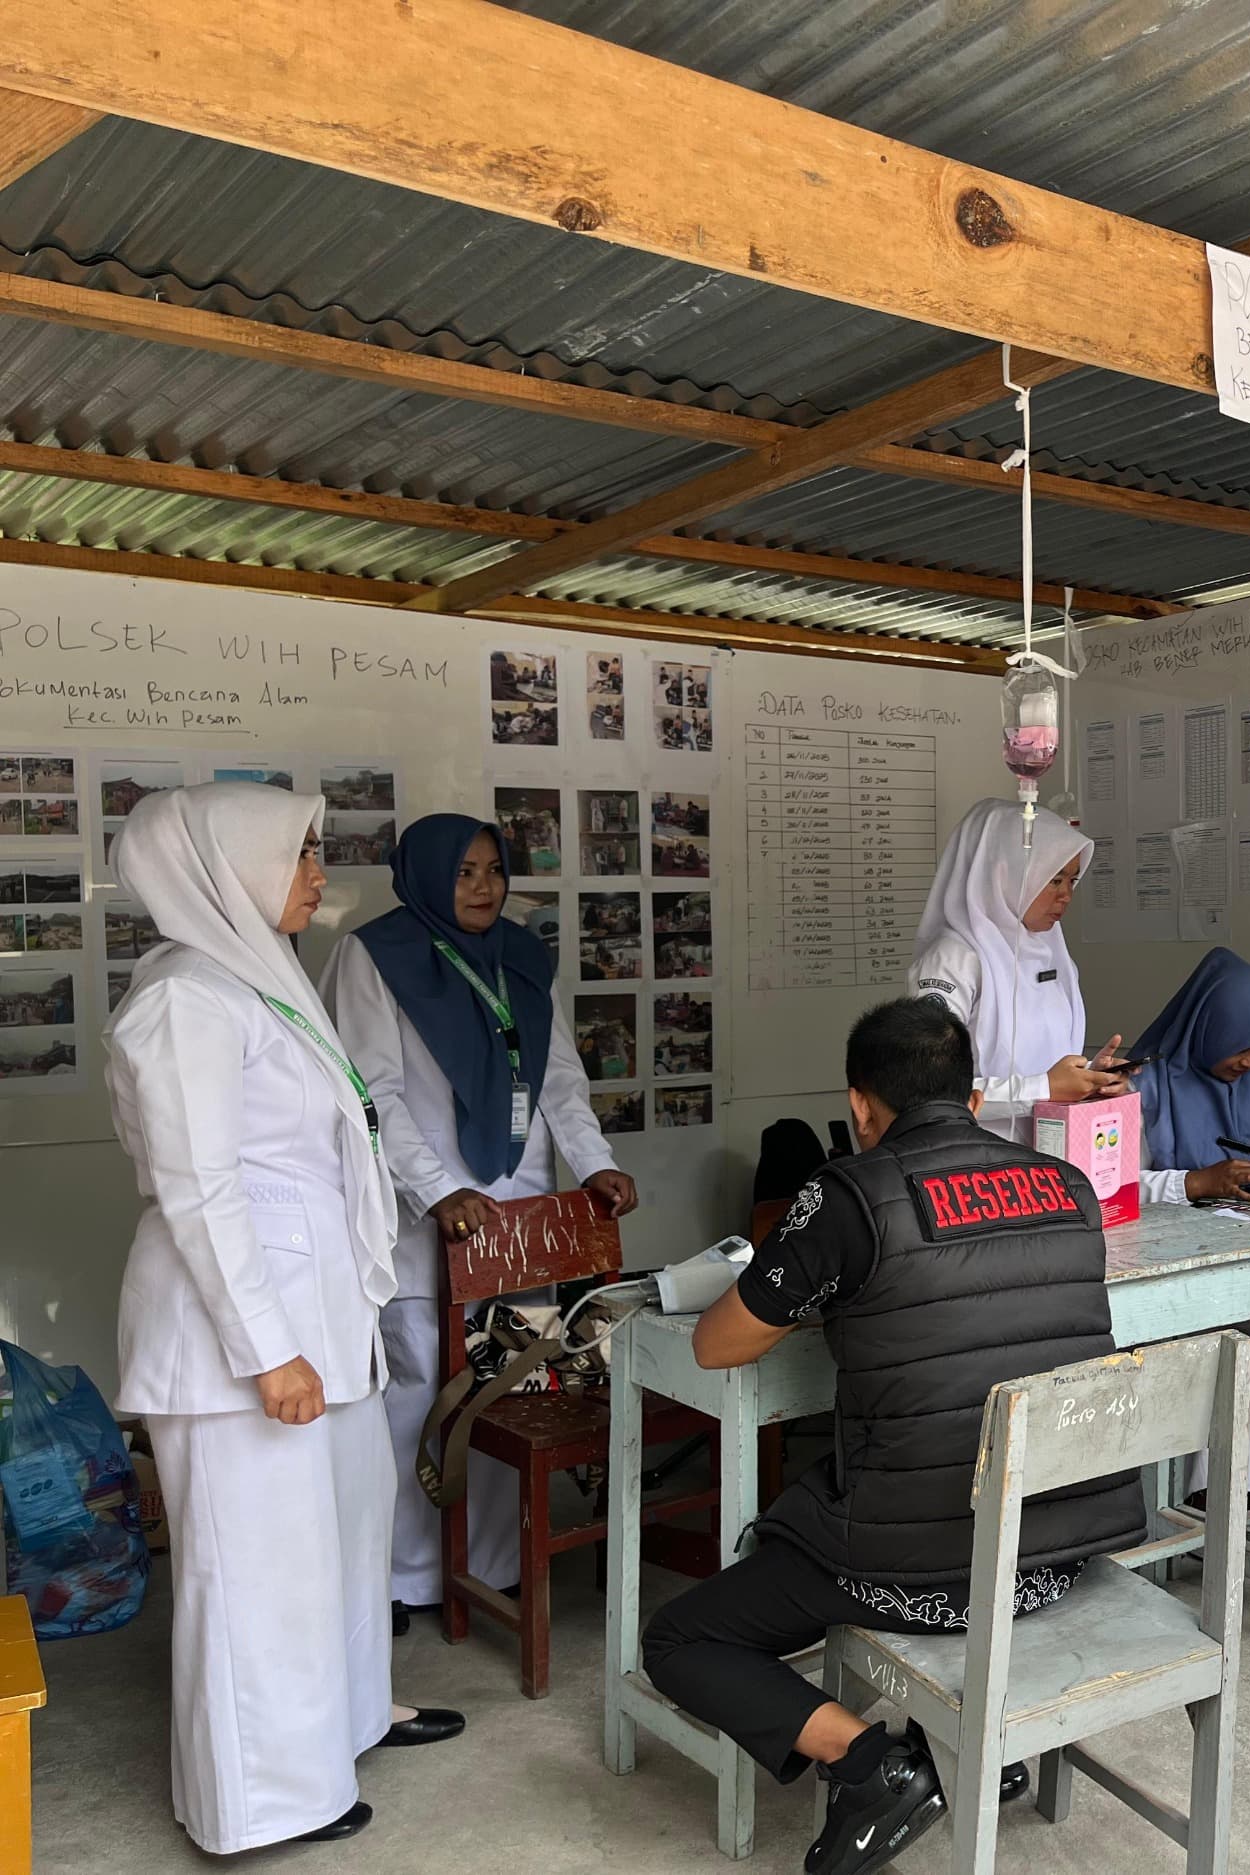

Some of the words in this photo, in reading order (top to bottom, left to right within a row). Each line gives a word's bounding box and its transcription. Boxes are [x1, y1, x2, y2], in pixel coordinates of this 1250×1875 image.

[0, 607, 188, 656] POLSEK
[217, 634, 301, 665] WIH
[330, 646, 449, 688] PESAM
[147, 680, 240, 705] Bencana
[258, 681, 308, 707] Alam
[758, 690, 806, 717] DATA
[923, 1167, 1078, 1228] RESERSE
